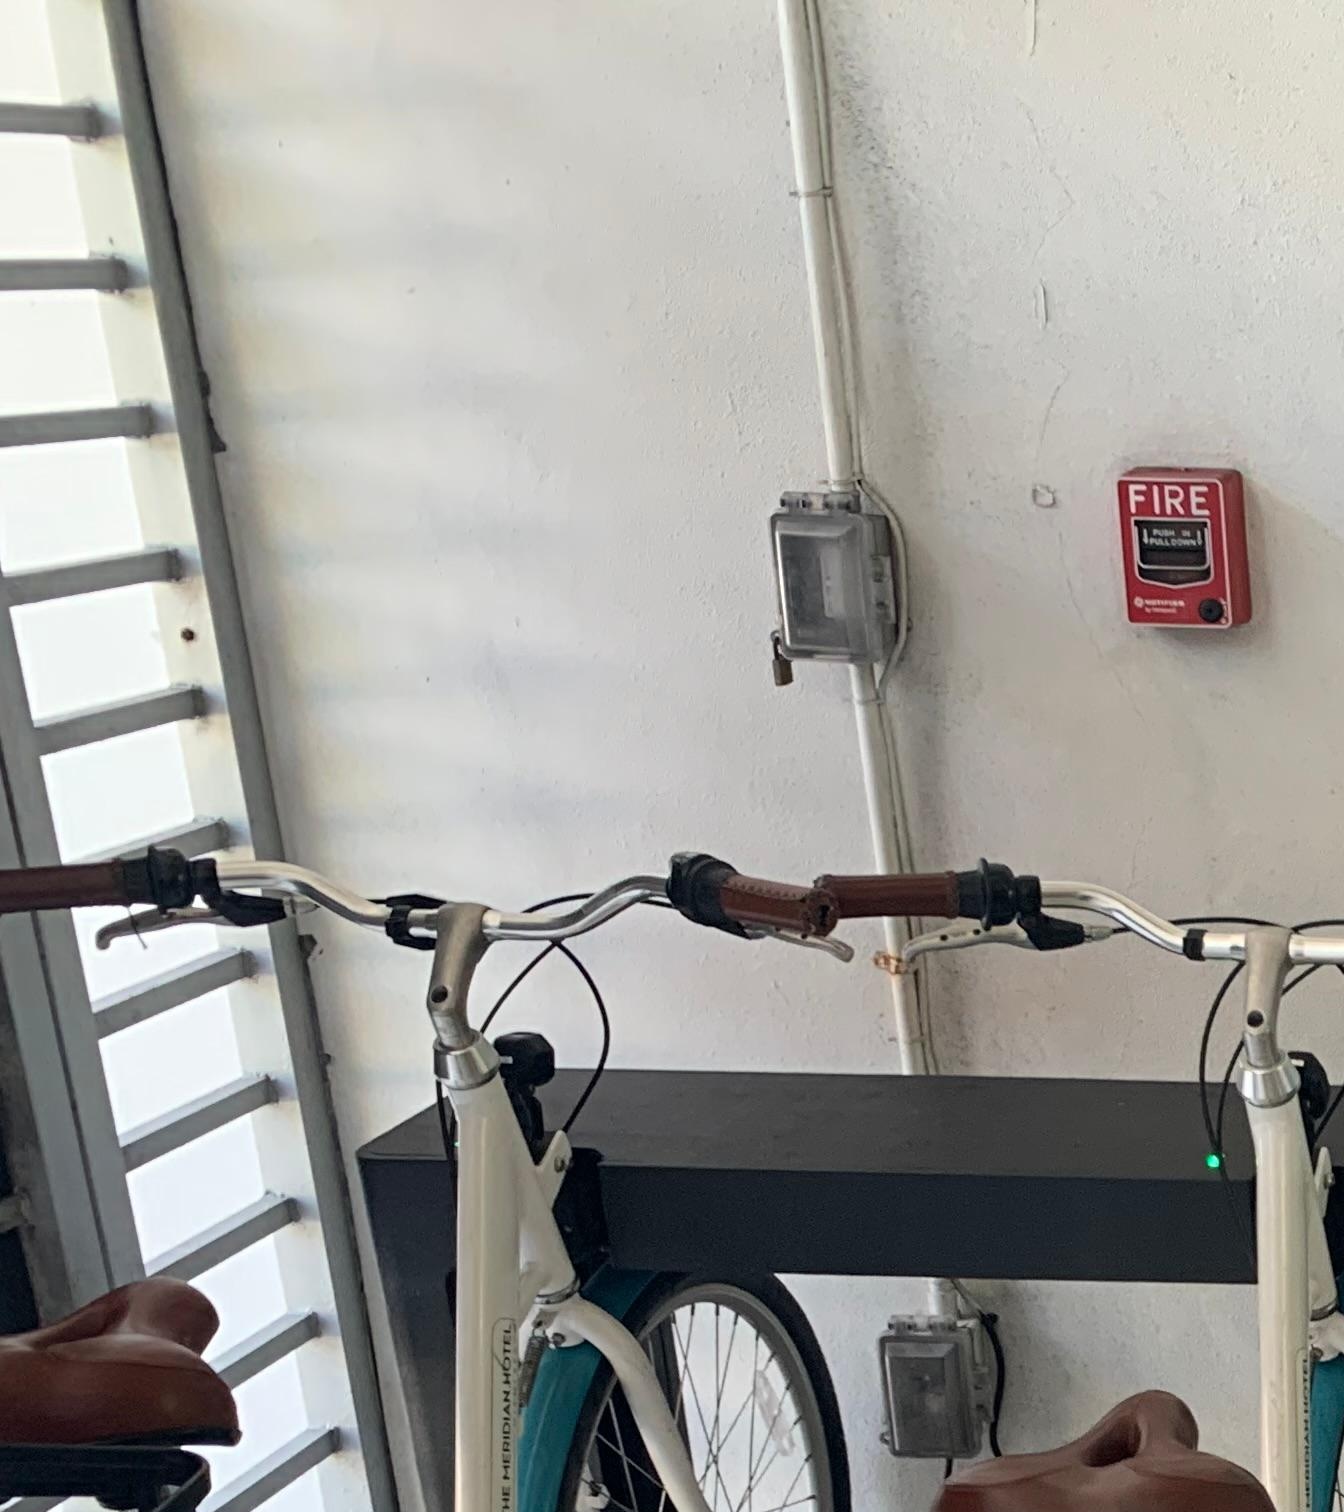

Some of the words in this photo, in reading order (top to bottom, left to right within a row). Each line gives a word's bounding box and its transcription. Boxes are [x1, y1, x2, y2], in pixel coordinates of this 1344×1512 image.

[1128, 484, 1210, 516] FIRE
[1149, 537, 1170, 546] PULL
[1171, 538, 1197, 546] DOWN
[1152, 528, 1175, 537] PUSH
[502, 1324, 513, 1385] HOTEL
[501, 1390, 512, 1480] MERIDIAN
